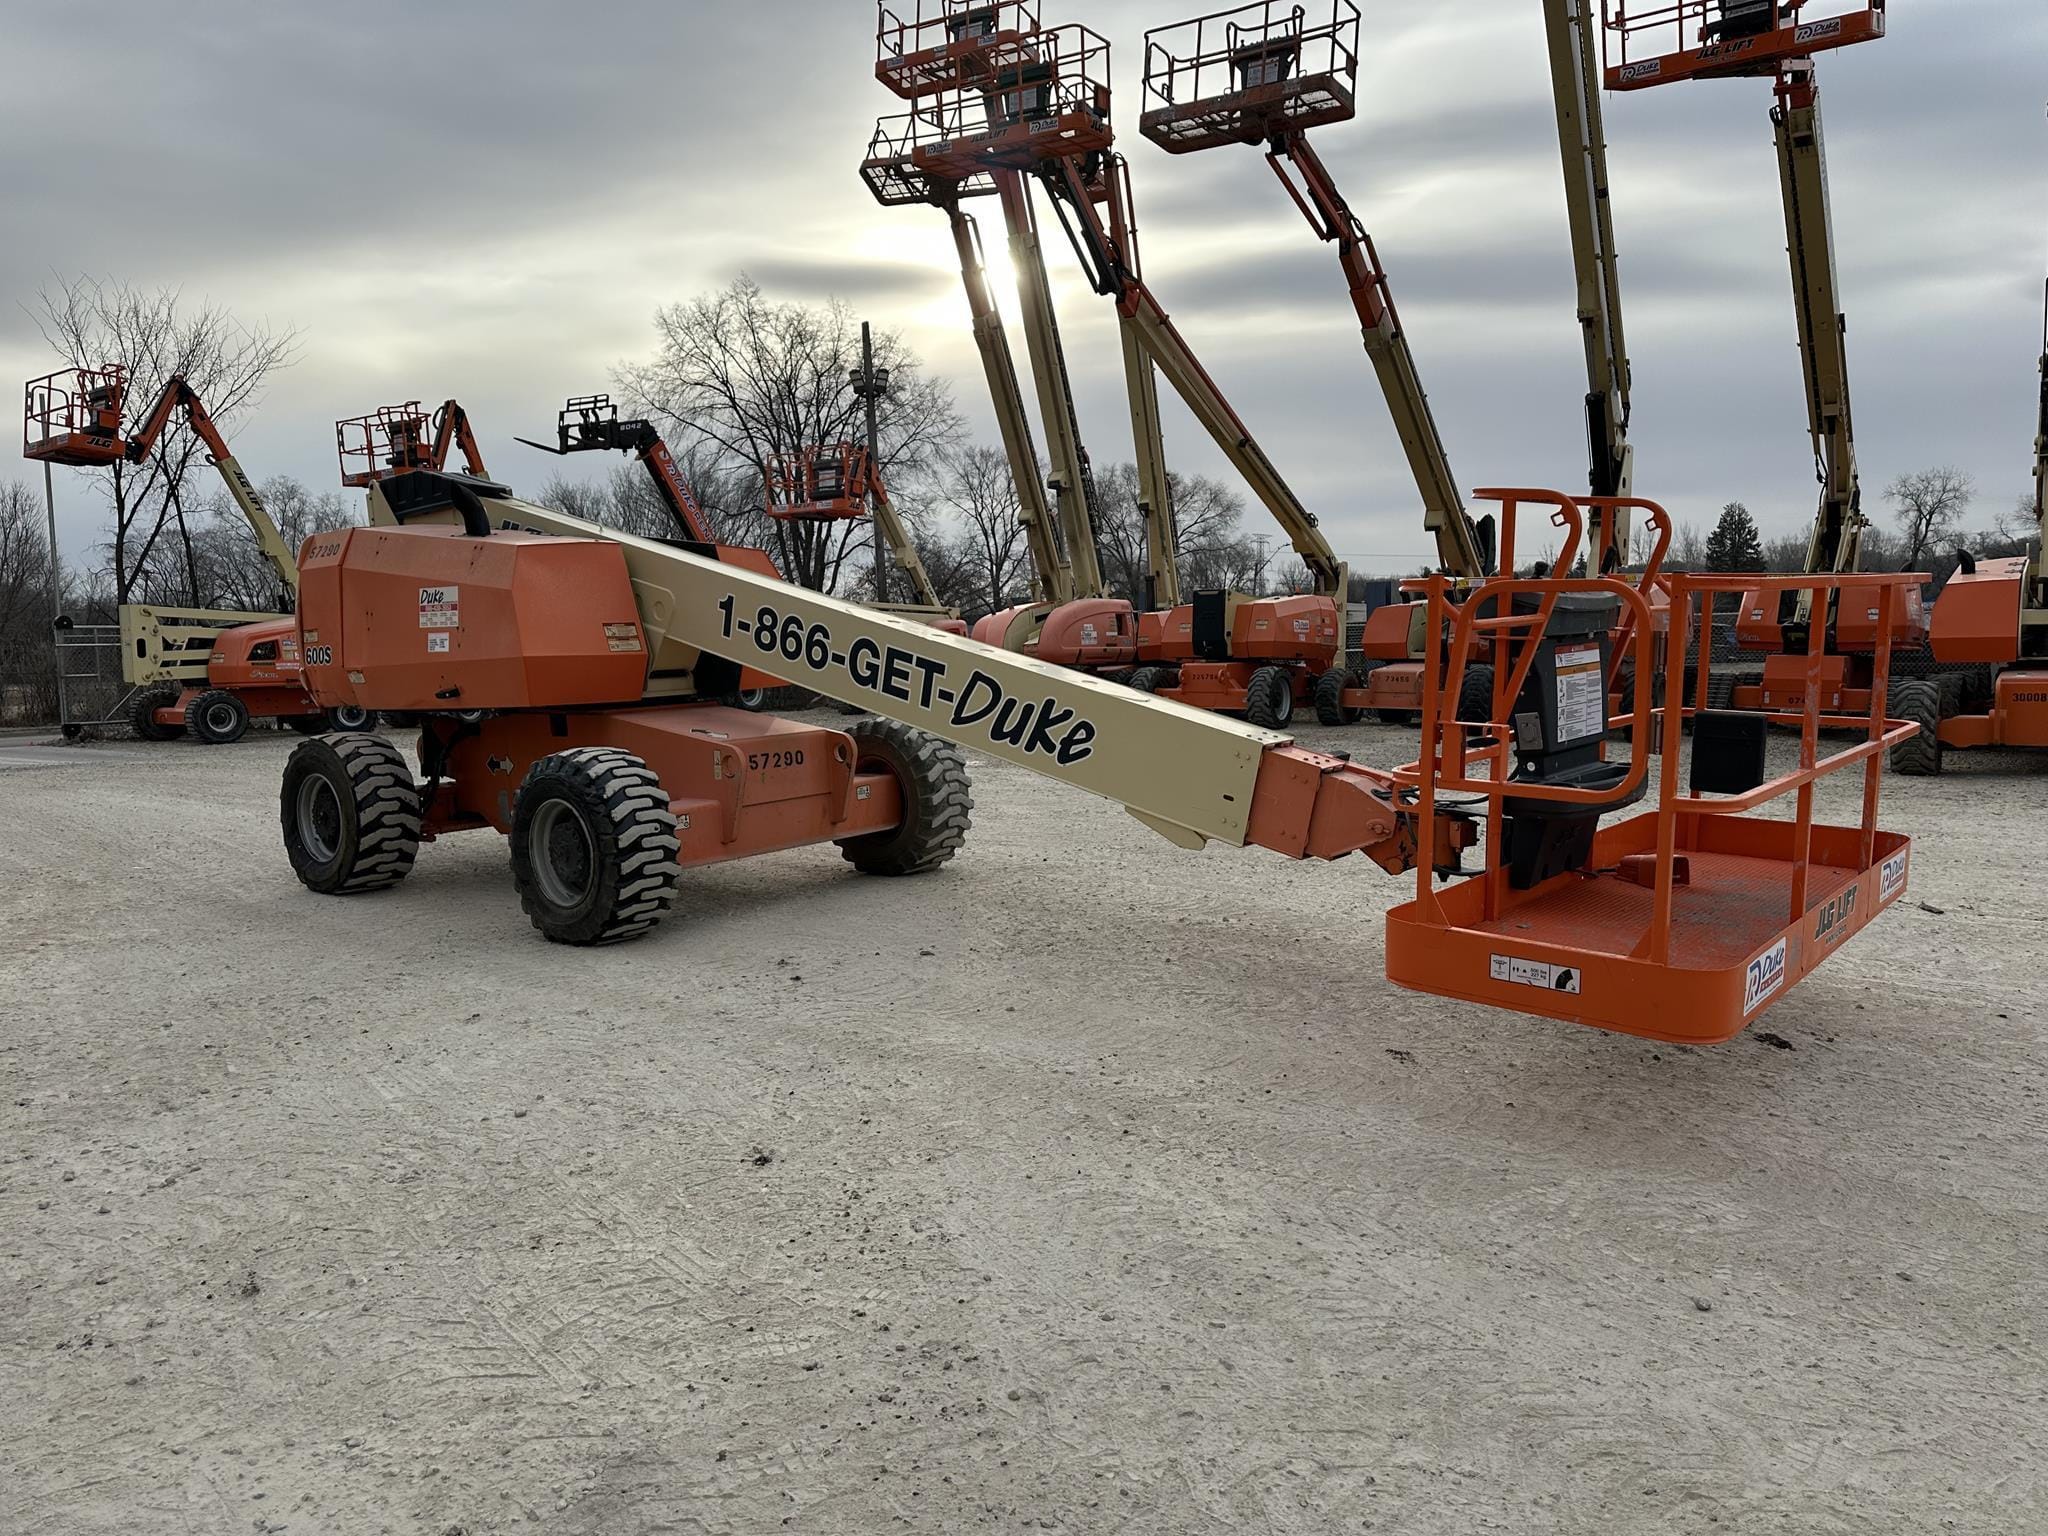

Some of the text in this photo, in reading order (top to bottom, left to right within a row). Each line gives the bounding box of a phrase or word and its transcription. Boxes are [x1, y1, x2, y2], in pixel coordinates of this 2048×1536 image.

[1815, 21, 1840, 33] Duke
[1696, 46, 1721, 60] JLG
[1725, 38, 1755, 53] LIFT
[1637, 62, 1659, 73] Duke
[989, 128, 1008, 139] LIFT
[87, 437, 113, 448] JLG
[233, 469, 265, 514] JLG LIFT
[674, 477, 697, 512] Duke
[309, 543, 341, 559] 57290
[420, 589, 444, 605] Duke
[306, 646, 332, 664] 600S
[717, 593, 1097, 768] 1-866-GET-Duke
[748, 750, 804, 770] 57290
[1815, 900, 1835, 941] JLG
[1836, 884, 1858, 925] LIFT
[1762, 946, 1785, 980] Duke
